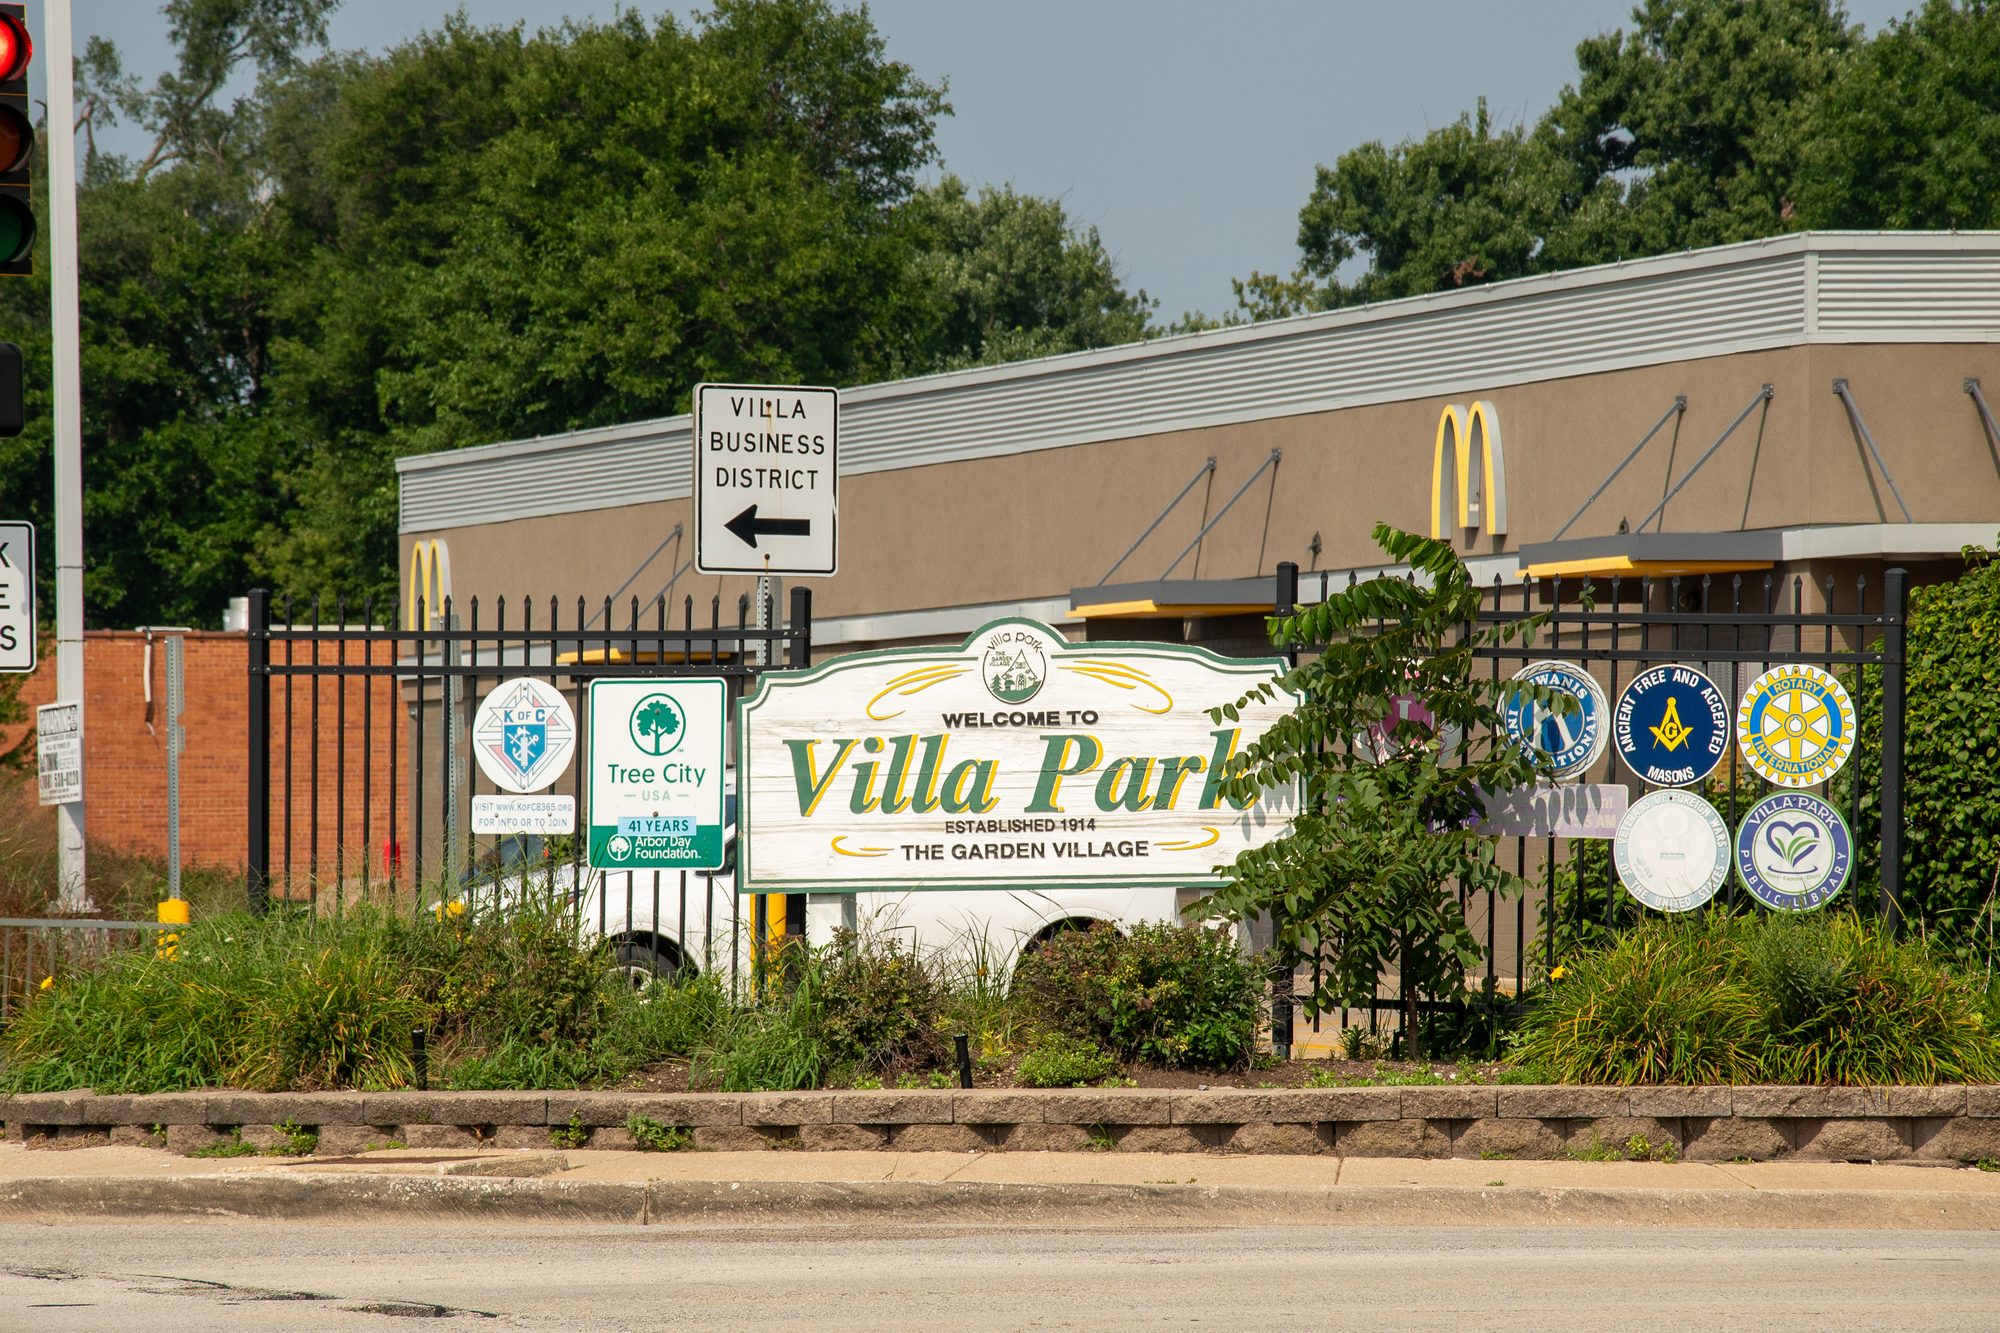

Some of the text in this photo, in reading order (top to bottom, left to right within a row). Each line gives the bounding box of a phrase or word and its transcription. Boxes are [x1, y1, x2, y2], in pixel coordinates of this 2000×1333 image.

[731, 396, 806, 419] VILLA
[710, 431, 825, 455] BUSINESS
[716, 467, 818, 489] DISTRICT
[987, 632, 1042, 653] villa park
[1773, 678, 1822, 694] ROTARY
[504, 709, 546, 724] K OF C
[942, 710, 1099, 729] WELCOME TO
[1618, 669, 1726, 755] ANCIENT FREE AND ACCEPTED
[1664, 721, 1678, 739] G
[1755, 741, 1836, 773] INTERNATIONAL
[608, 763, 706, 788] Tree City
[782, 728, 1260, 817] Villa Park
[1647, 765, 1695, 783] MASONS
[642, 790, 671, 801] USA
[474, 803, 494, 811] VISIT
[1748, 796, 1839, 829] VILLA PARK
[479, 818, 568, 827] FOR INFO OR TO JOIN
[628, 820, 689, 832] 41 YEARS
[945, 818, 1096, 834] ESTABLISHED 1914
[1617, 800, 1650, 845] VETERANS
[1655, 794, 1668, 804] OF
[1674, 794, 1712, 818] FOREIGN
[1711, 820, 1728, 848] WARS
[635, 836, 691, 849] Arbor Day
[635, 847, 699, 859] Foundation
[901, 840, 1149, 861] THE GARDEN VILLAGE
[1620, 863, 1725, 908] OF THE UNITED STATES
[1741, 849, 1847, 906] PUBLIC LIBRARY
